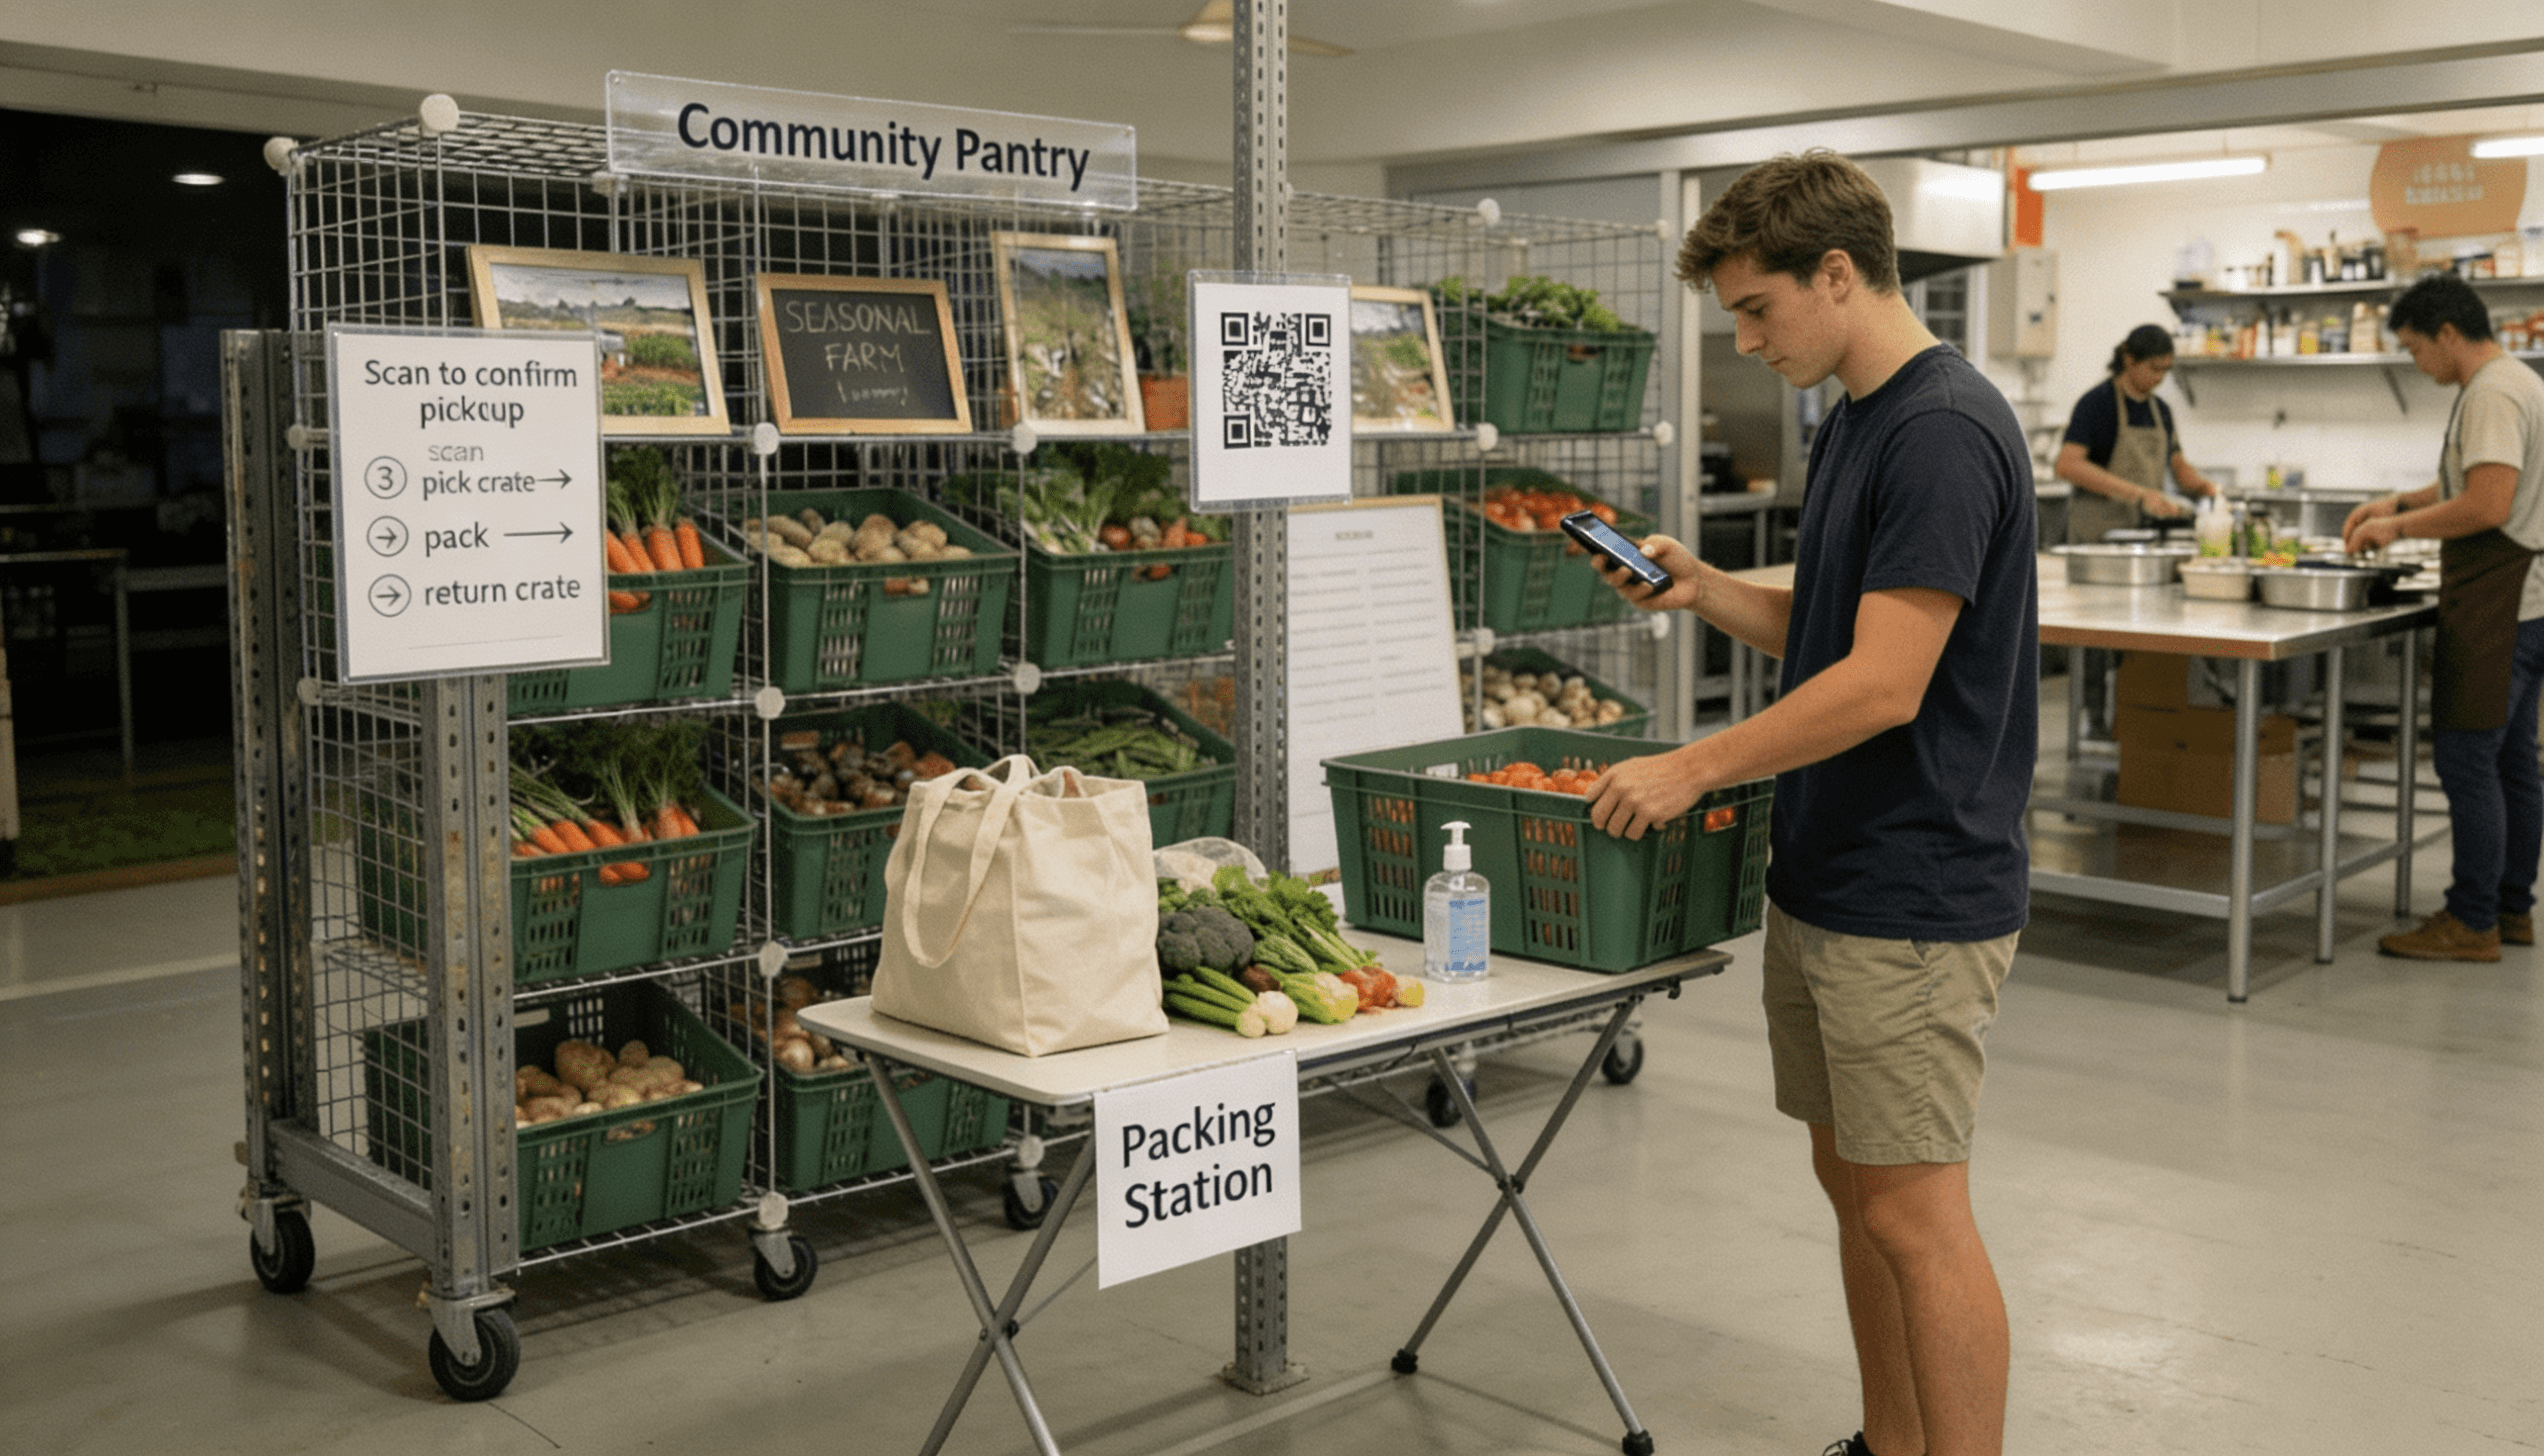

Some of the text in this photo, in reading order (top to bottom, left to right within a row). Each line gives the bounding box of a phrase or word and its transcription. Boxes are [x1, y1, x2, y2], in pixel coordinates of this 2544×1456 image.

[678, 101, 1090, 191] Community Pantry
[786, 300, 930, 334] SEASONAL
[365, 358, 577, 387] Scan to confirm
[824, 341, 904, 373] FARM
[428, 445, 484, 462] scan
[377, 465, 535, 501] 3 pick crate
[425, 521, 489, 557] pack
[425, 575, 581, 606] return crate
[1122, 1102, 1276, 1169] Packing
[1124, 1162, 1273, 1229] Station
